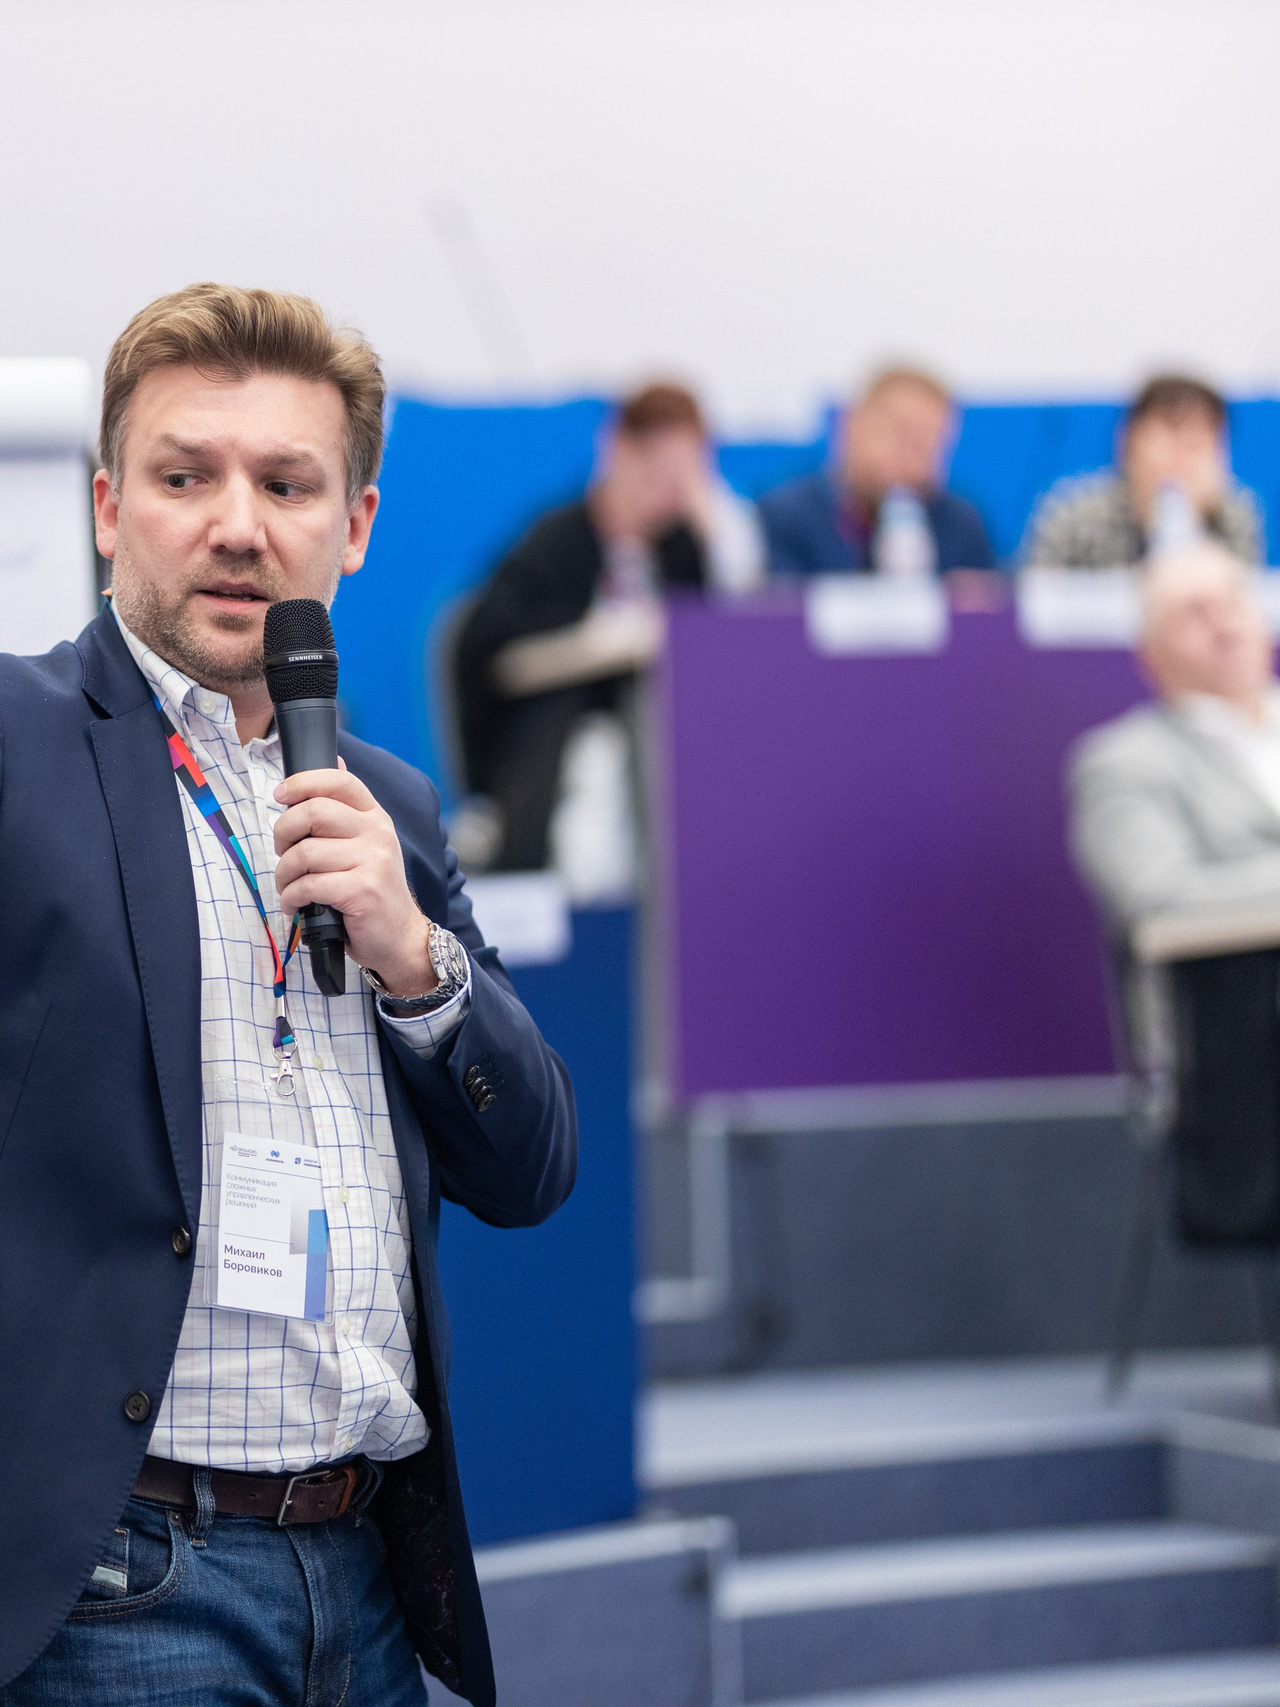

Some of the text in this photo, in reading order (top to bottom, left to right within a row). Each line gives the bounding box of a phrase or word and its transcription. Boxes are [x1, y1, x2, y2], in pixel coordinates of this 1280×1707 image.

[288, 654, 323, 662] SENNHEISER
[226, 1172, 278, 1187] Коммуникация
[225, 1182, 257, 1193] сложных
[225, 1190, 281, 1205] управленческих
[225, 1198, 257, 1209] решений
[224, 1244, 266, 1260] Михаил
[223, 1259, 283, 1278] Боровиков
